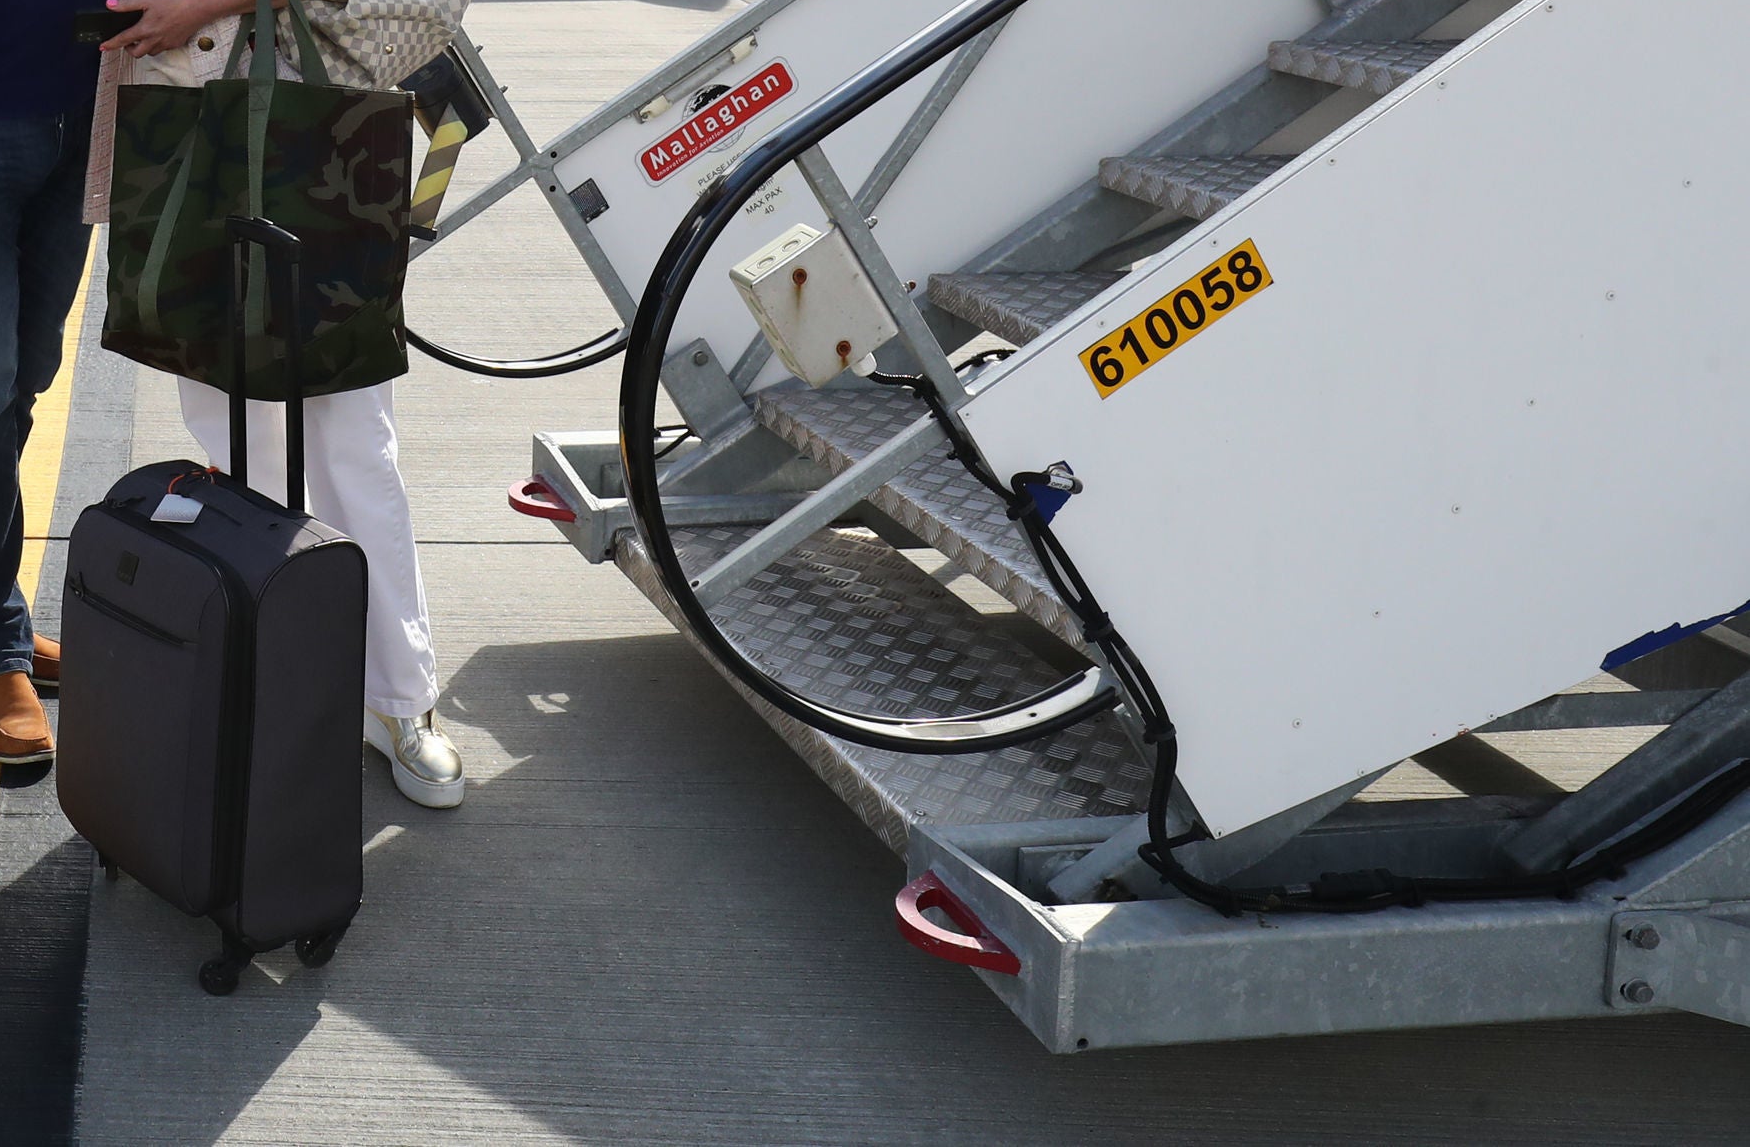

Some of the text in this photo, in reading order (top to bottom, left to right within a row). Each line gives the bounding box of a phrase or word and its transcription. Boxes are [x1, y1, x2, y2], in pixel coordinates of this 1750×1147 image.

[649, 74, 780, 170] Mallaghan
[656, 128, 725, 178] Innovation for Aviation
[698, 163, 725, 186] PLEASE
[745, 186, 783, 215] MAX PAX
[764, 204, 775, 215] 40
[1089, 250, 1263, 387] 610058
